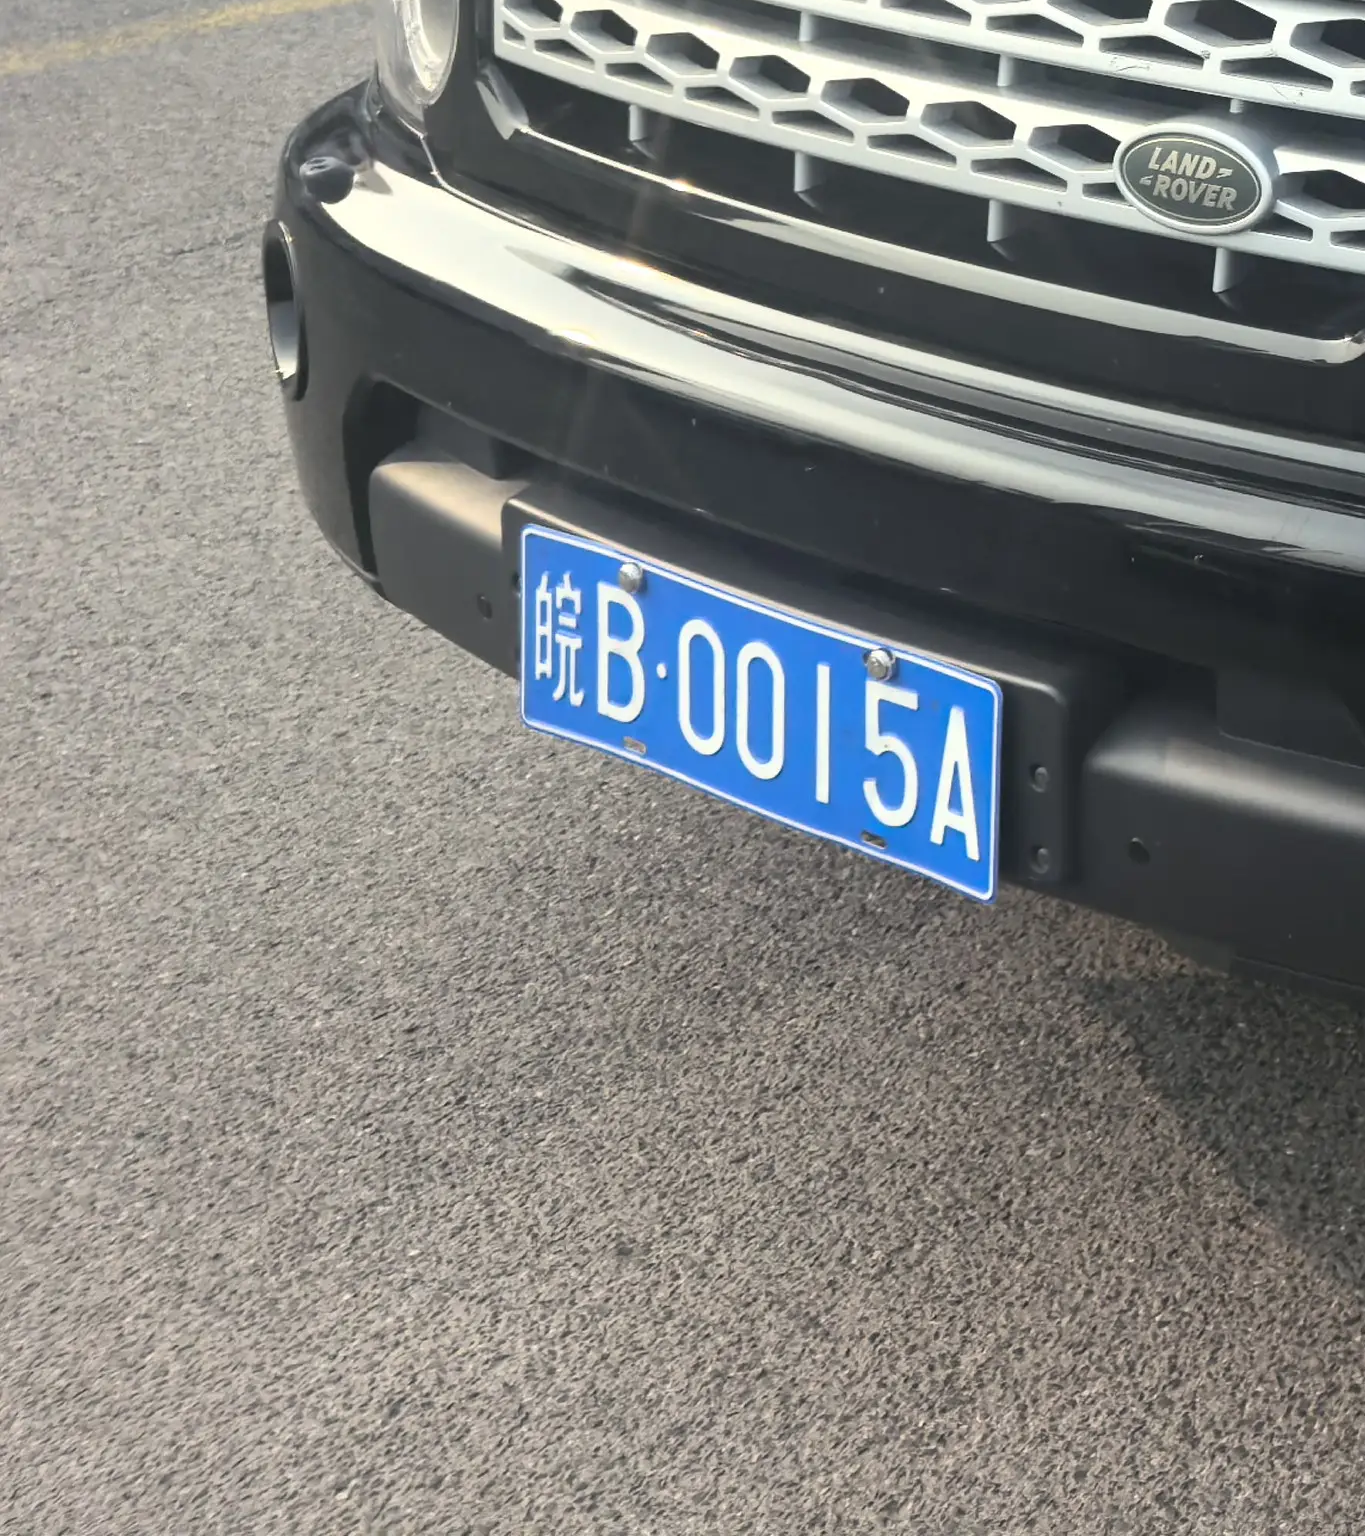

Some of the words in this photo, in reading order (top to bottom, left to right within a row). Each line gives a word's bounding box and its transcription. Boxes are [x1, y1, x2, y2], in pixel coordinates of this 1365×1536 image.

[1148, 146, 1217, 181] LAND
[1152, 173, 1238, 212] ROVER
[533, 570, 980, 862] 皖B·0015A
